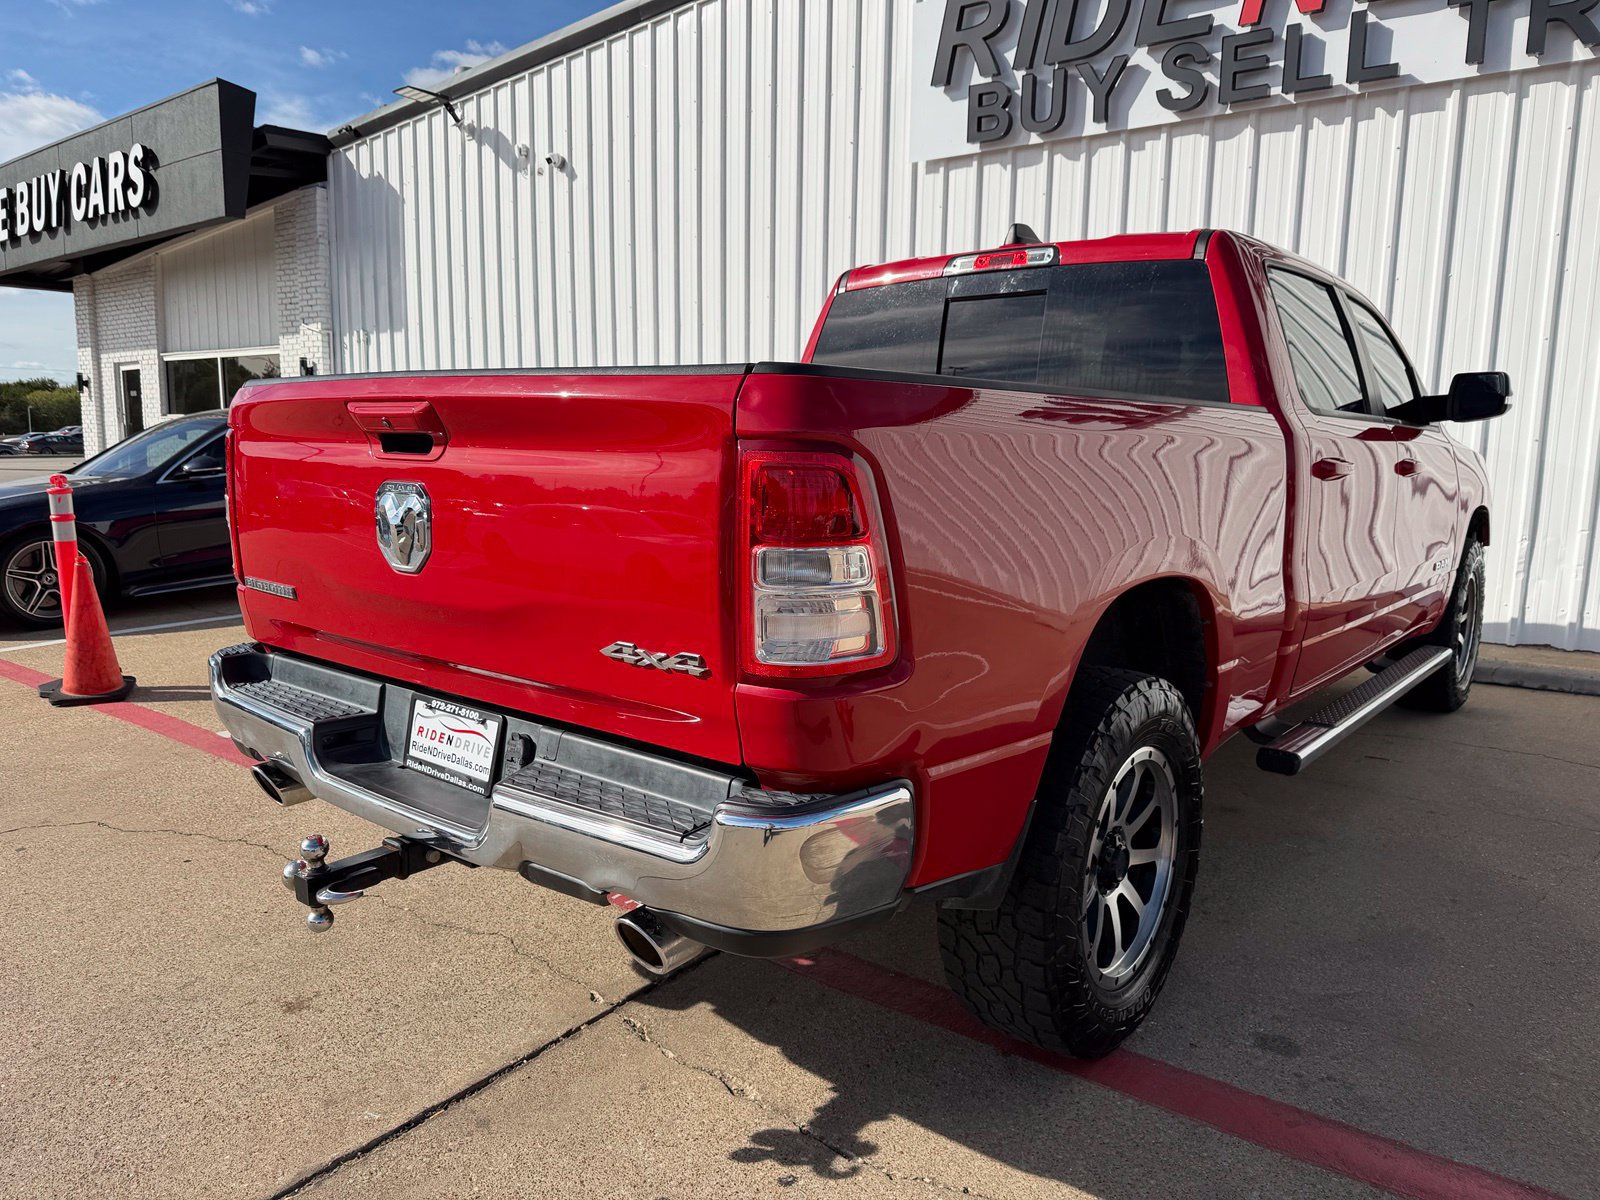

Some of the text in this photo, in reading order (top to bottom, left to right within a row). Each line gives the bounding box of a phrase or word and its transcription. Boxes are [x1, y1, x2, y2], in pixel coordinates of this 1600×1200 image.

[967, 54, 1129, 143] BUY
[1156, 10, 1400, 112] SELL
[16, 169, 61, 237] BUY
[71, 143, 145, 222] CARS
[432, 700, 480, 720] 972-271-5100
[411, 741, 489, 775] RideNDriveDallas.com
[407, 760, 485, 794] RideNDriveDallas.com
